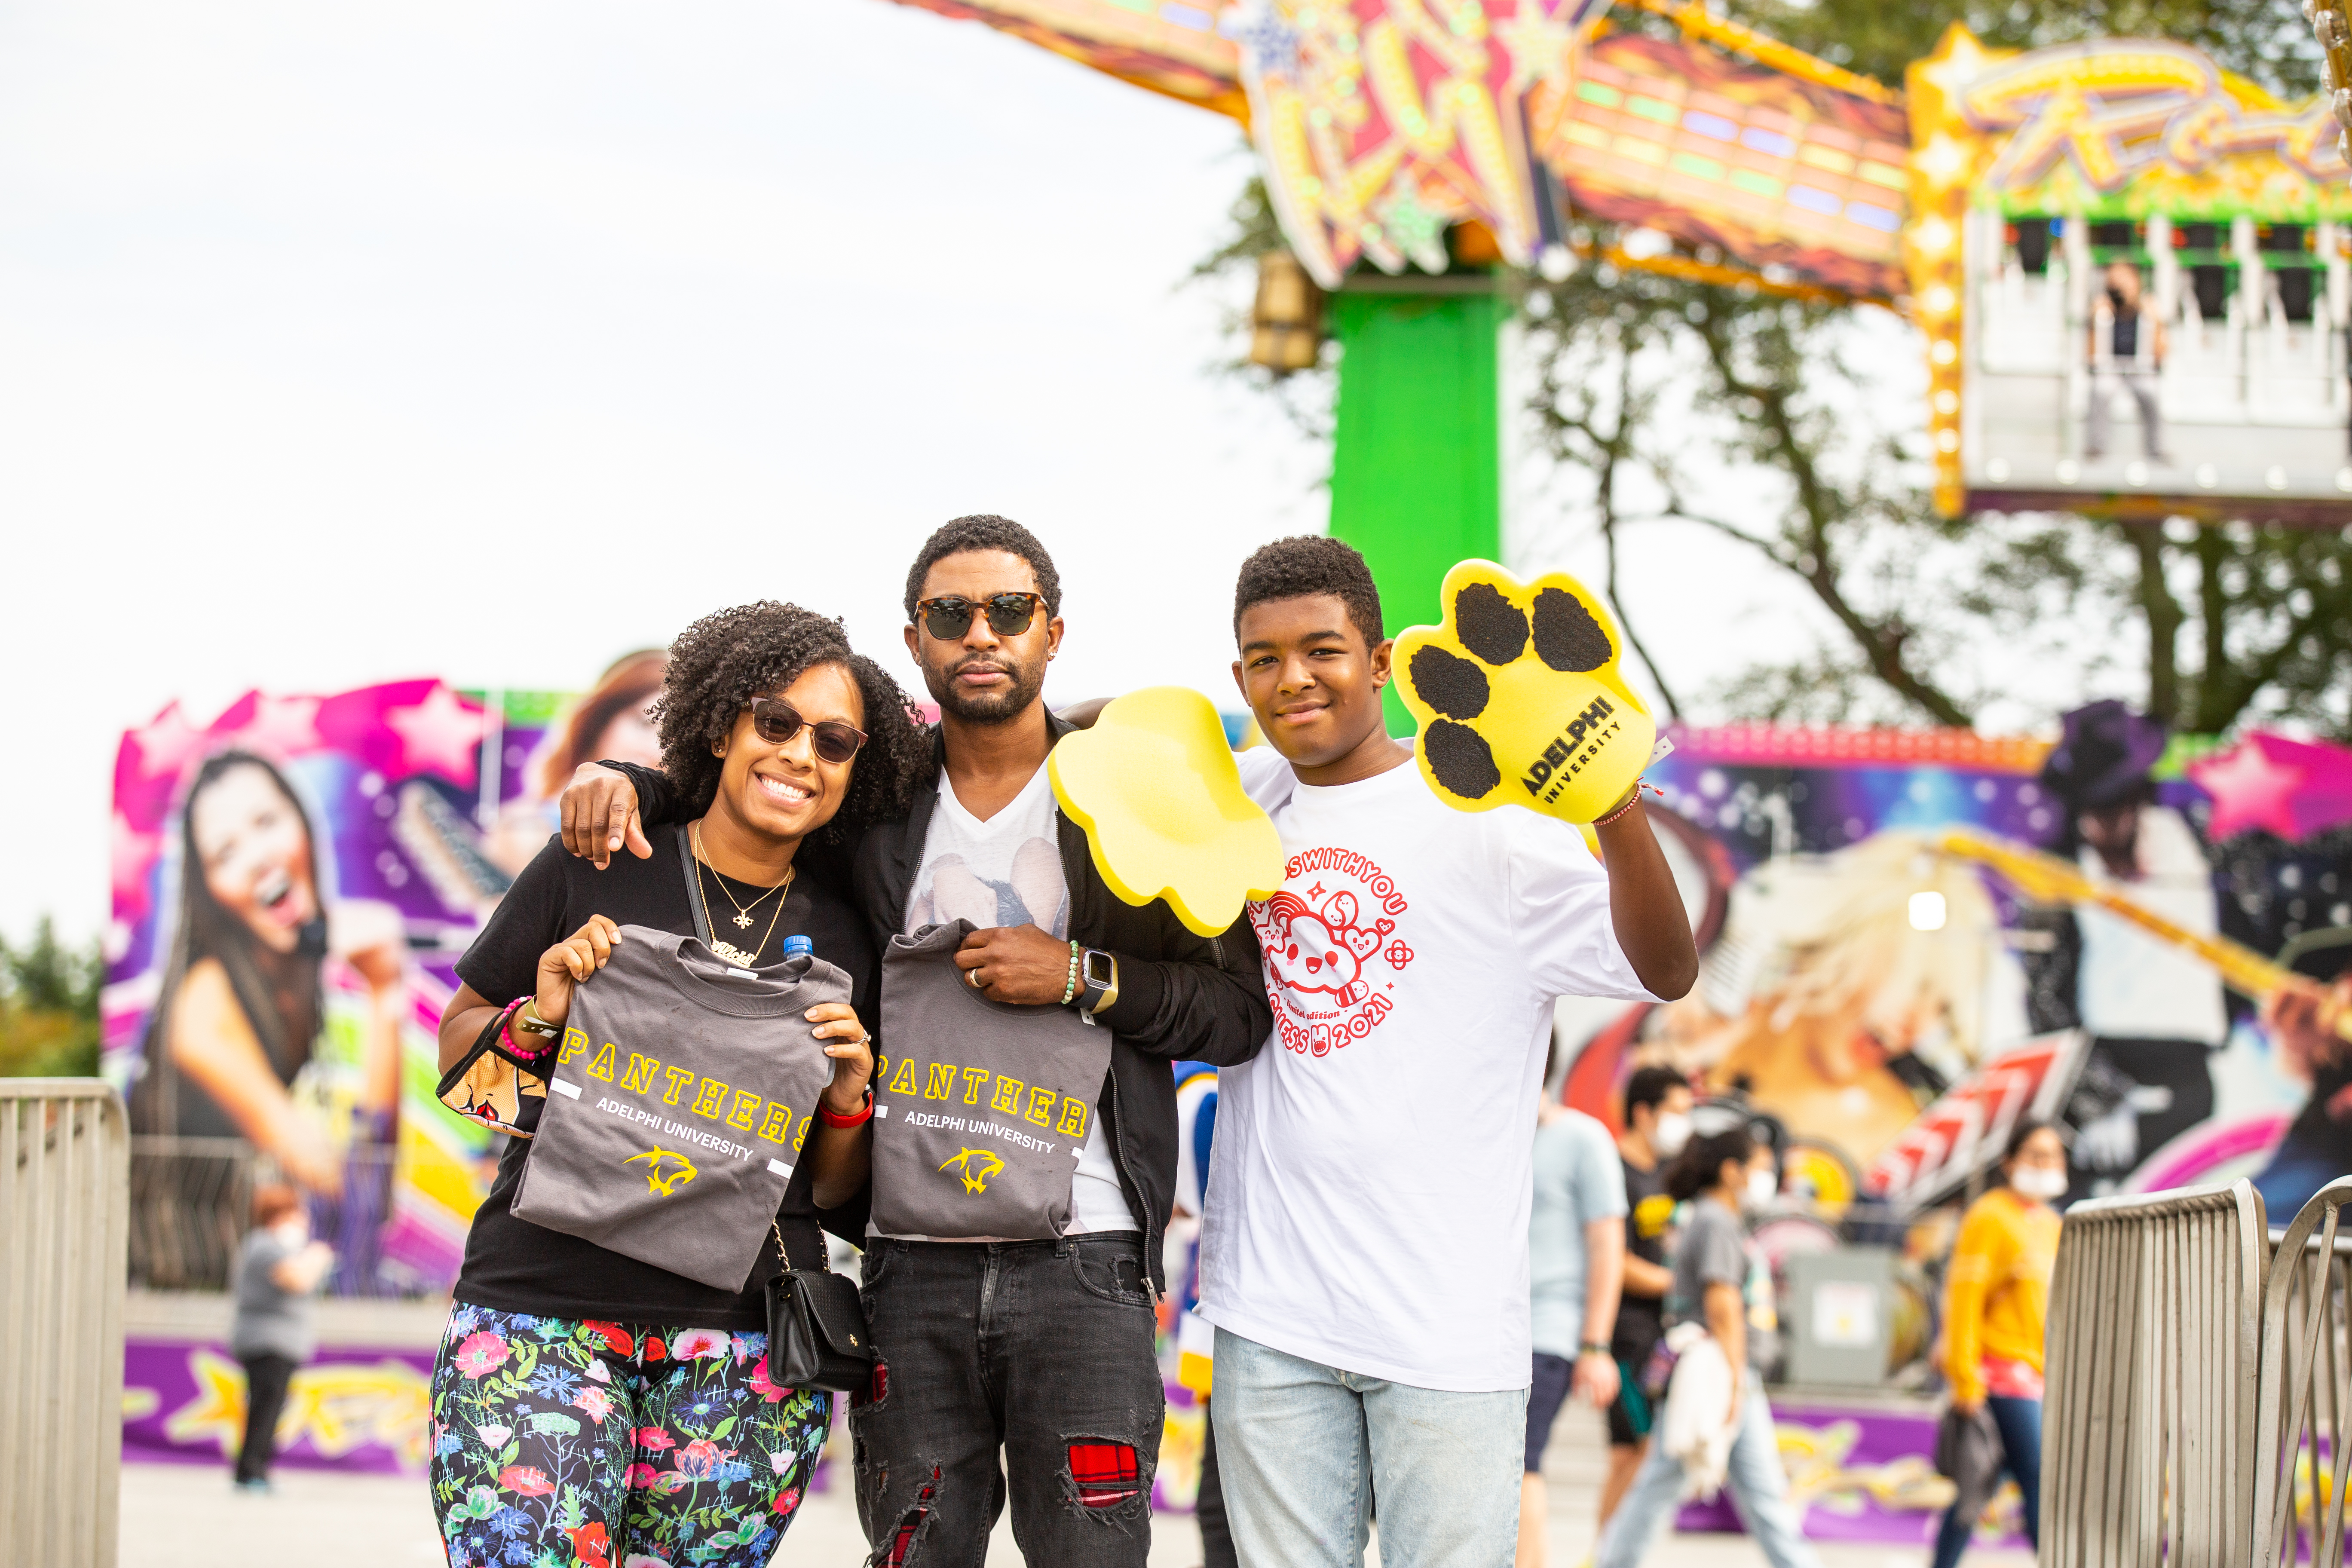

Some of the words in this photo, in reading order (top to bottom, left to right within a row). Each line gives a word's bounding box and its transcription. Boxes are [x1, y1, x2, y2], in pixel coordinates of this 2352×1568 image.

[1520, 695, 1614, 796] ADELPHI
[1544, 721, 1620, 803] UNIVERSITY
[1287, 999, 1305, 1018] limited
[1306, 1011, 1340, 1020] edition
[1332, 993, 1393, 1049] 2021
[596, 1096, 662, 1127] ADELPHI
[664, 1117, 754, 1161] UNIVERSITY
[904, 1111, 965, 1130] ADELPHI
[968, 1120, 1056, 1153] UNIVERSITY
